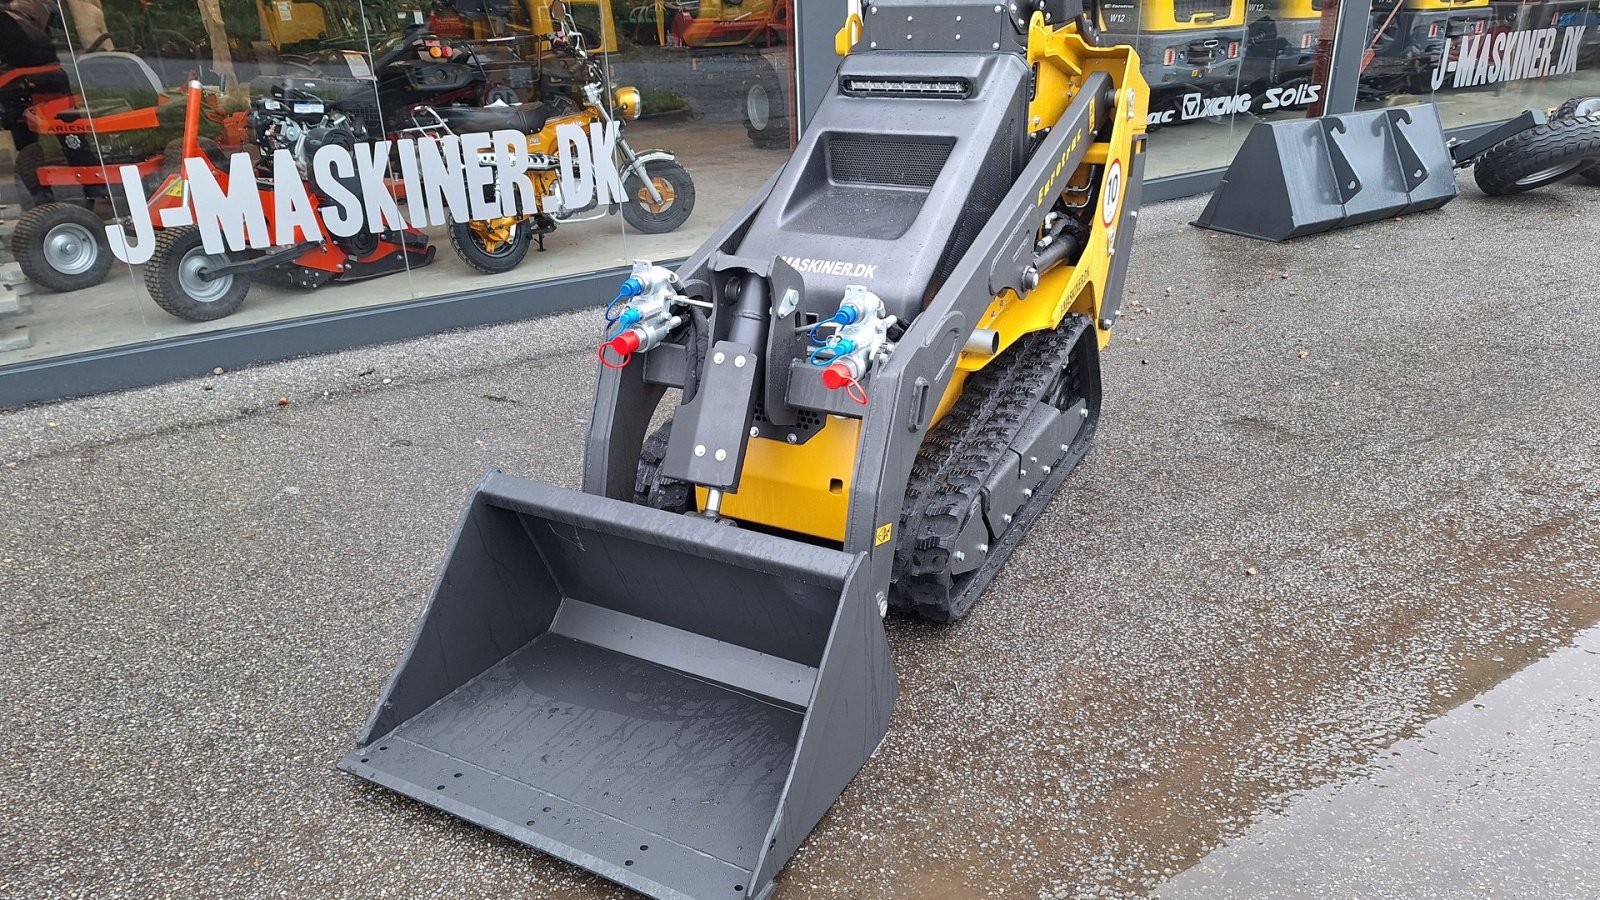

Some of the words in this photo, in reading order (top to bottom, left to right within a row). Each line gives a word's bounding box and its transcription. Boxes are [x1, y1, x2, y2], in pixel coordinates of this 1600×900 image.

[1431, 25, 1587, 91] J-MASKINER.DK
[48, 125, 94, 133] ARIENS
[1202, 93, 1252, 118] XCMG
[1037, 127, 1082, 208] Eurotrac
[1107, 174, 1119, 207] 10
[105, 120, 629, 266] J-MASKINER.DK
